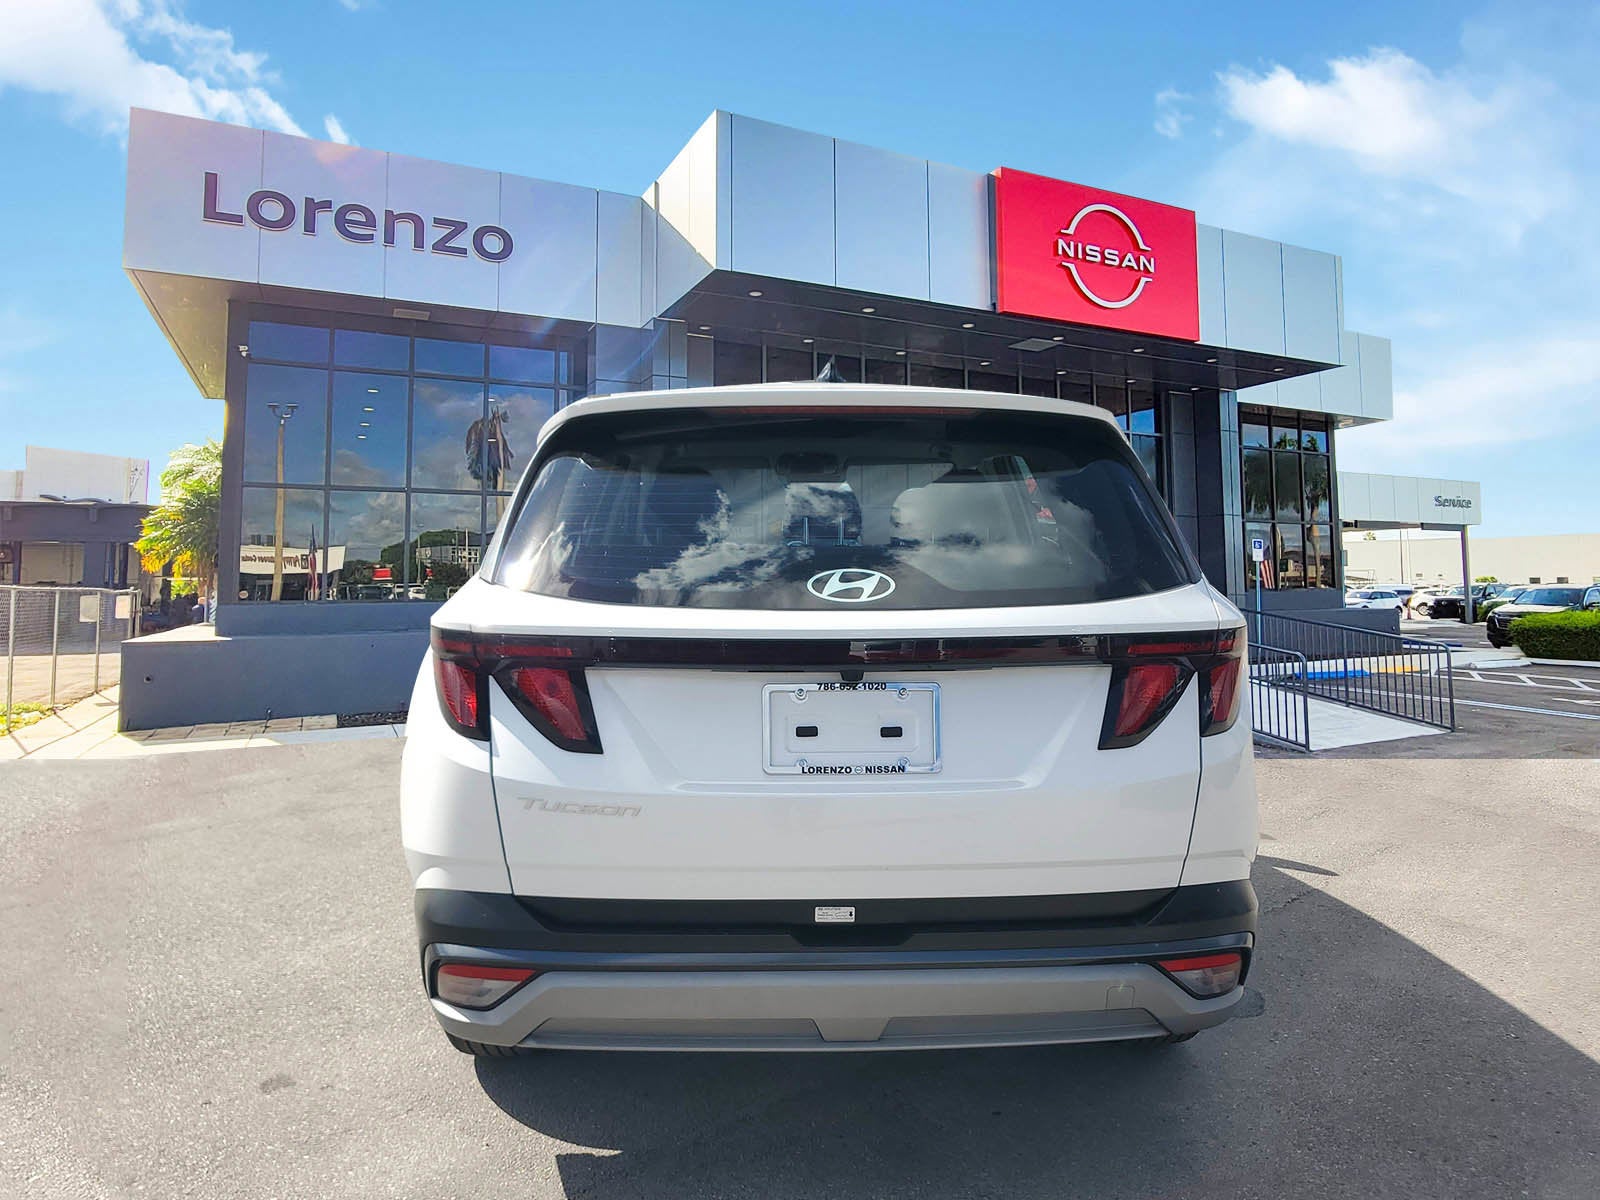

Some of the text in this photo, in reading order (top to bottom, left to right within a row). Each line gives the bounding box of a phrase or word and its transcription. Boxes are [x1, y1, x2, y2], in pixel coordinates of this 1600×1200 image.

[202, 171, 514, 263] Lorenzo
[1057, 238, 1155, 273] NISSAN
[1434, 495, 1472, 509] Service
[801, 766, 852, 774] LORENZO
[865, 765, 905, 774] NISSAN
